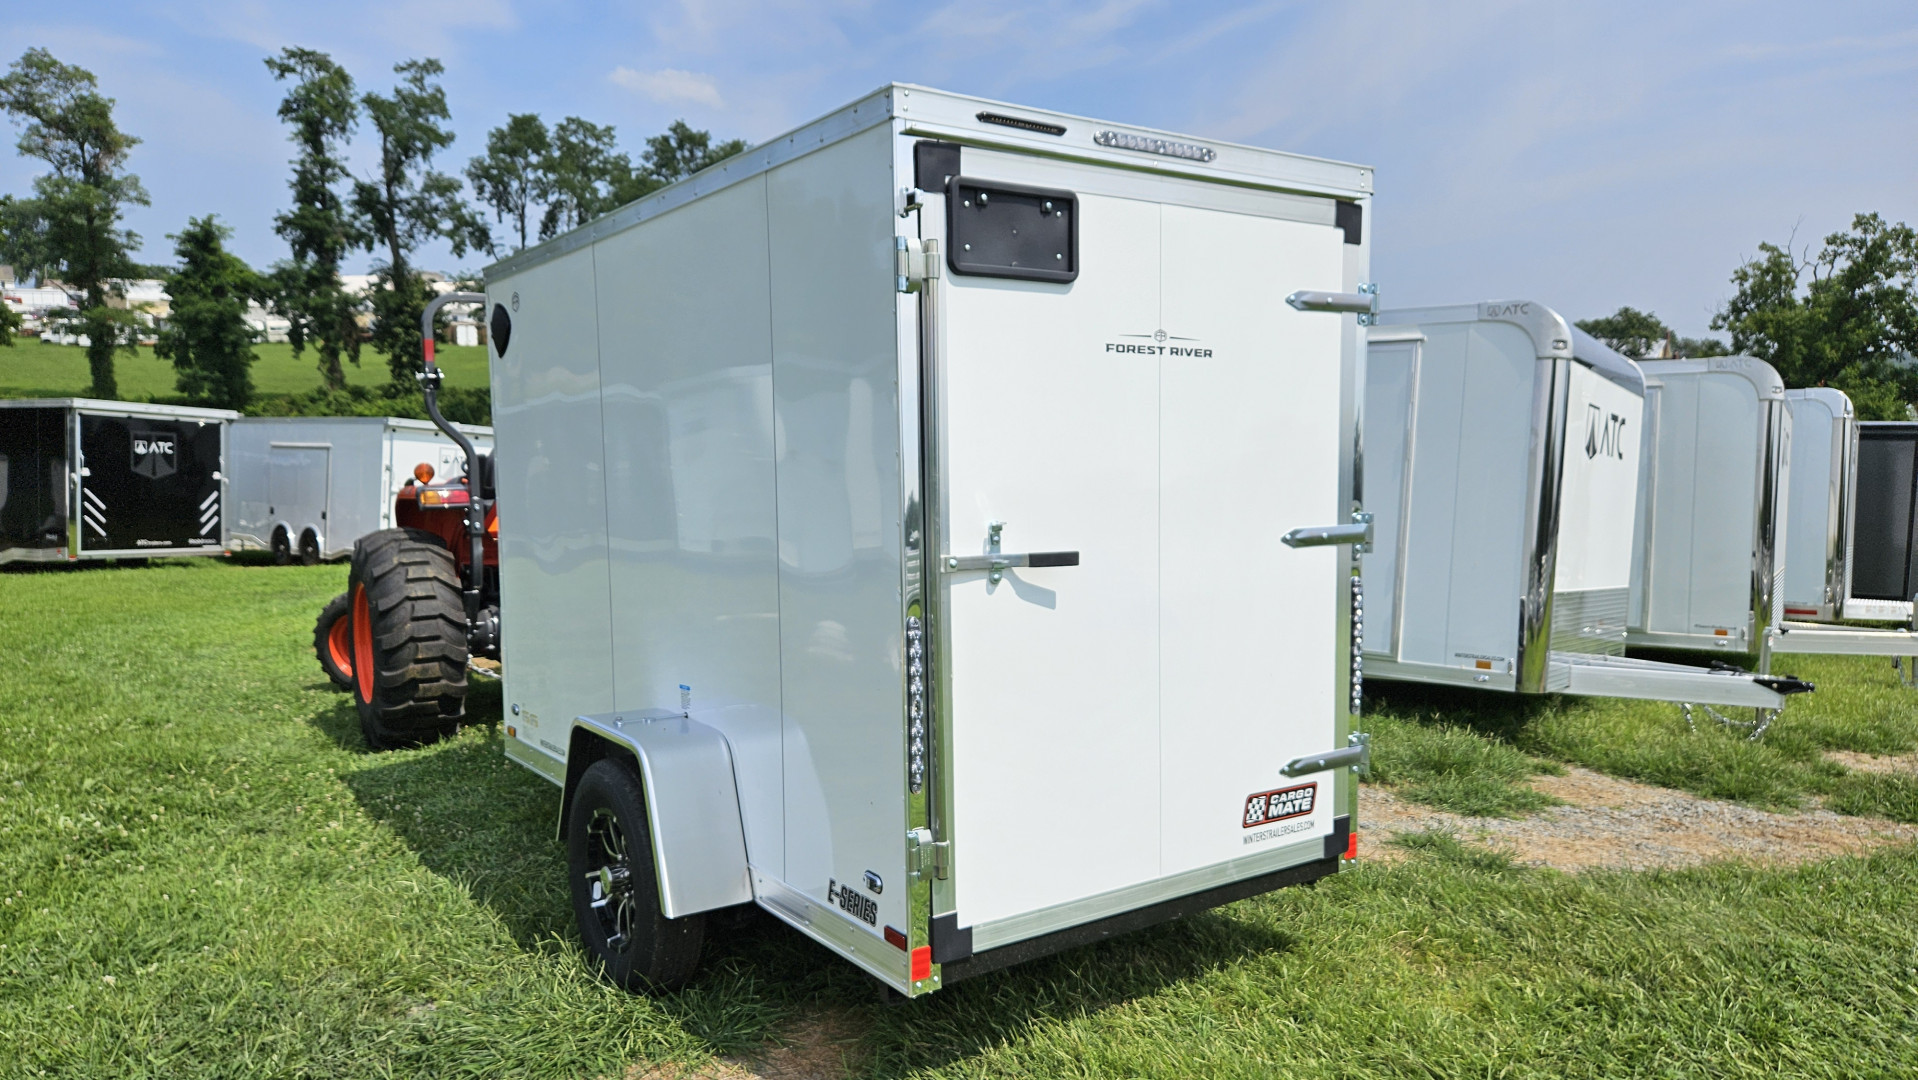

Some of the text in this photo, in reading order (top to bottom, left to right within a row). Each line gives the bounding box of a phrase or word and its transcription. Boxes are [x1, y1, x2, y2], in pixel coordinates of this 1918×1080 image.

[1502, 303, 1529, 316] ATC
[1105, 343, 1213, 358] FOREST RIVER
[1599, 411, 1626, 460] ATC
[148, 441, 174, 455] ATC
[1270, 788, 1313, 804] CARGO
[1267, 797, 1312, 818] MATE
[1243, 820, 1315, 844] WINTERSTRAILERSALES.COM
[828, 878, 878, 927] E-SERIES
